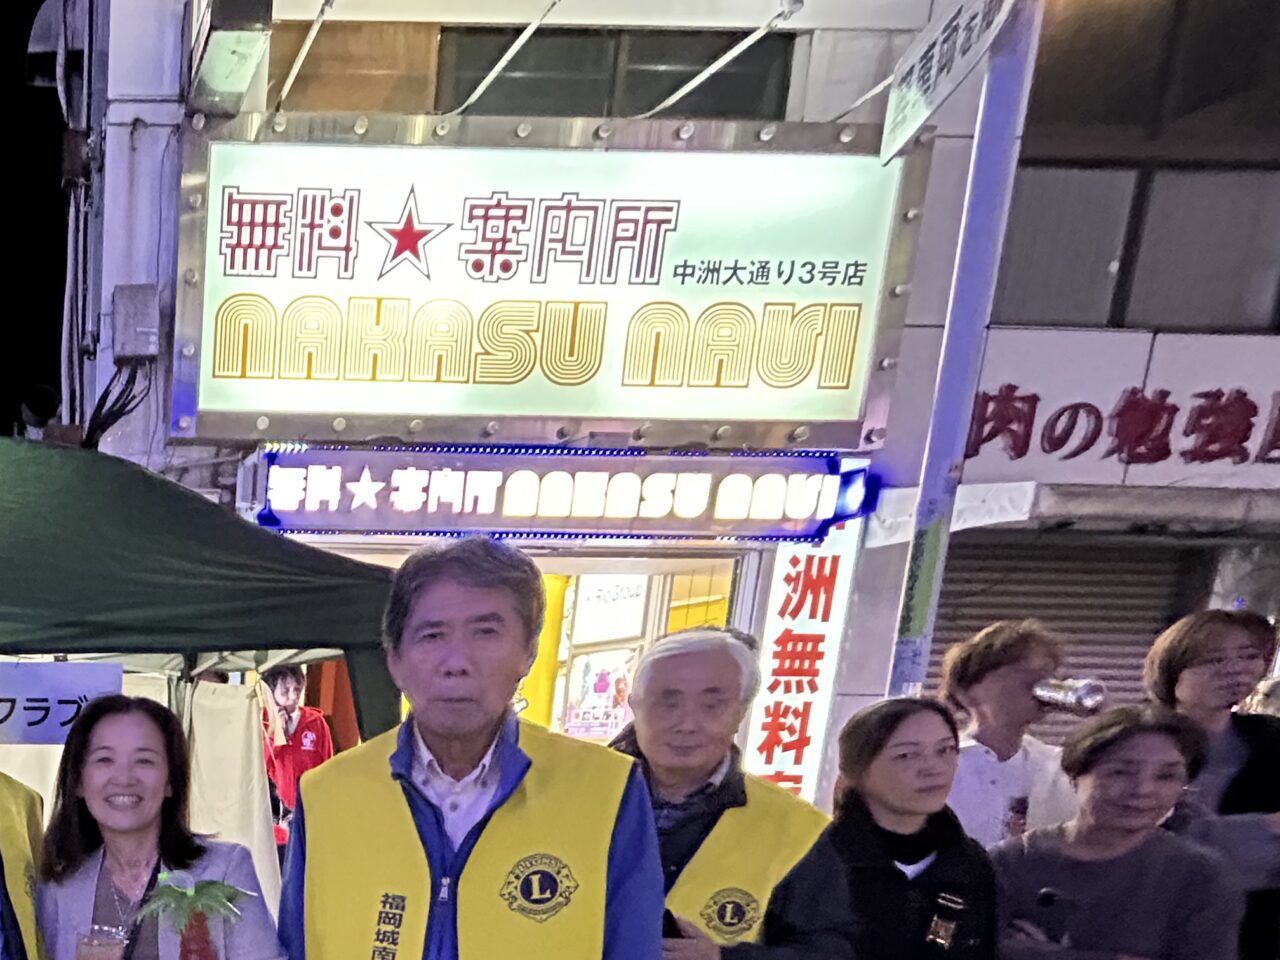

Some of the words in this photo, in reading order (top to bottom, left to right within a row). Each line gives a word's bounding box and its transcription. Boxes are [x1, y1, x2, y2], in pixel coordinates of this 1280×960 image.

[672, 259, 868, 287] 中洲大通り3号店
[212, 294, 608, 384] NAKASU
[622, 302, 863, 390] NAVI
